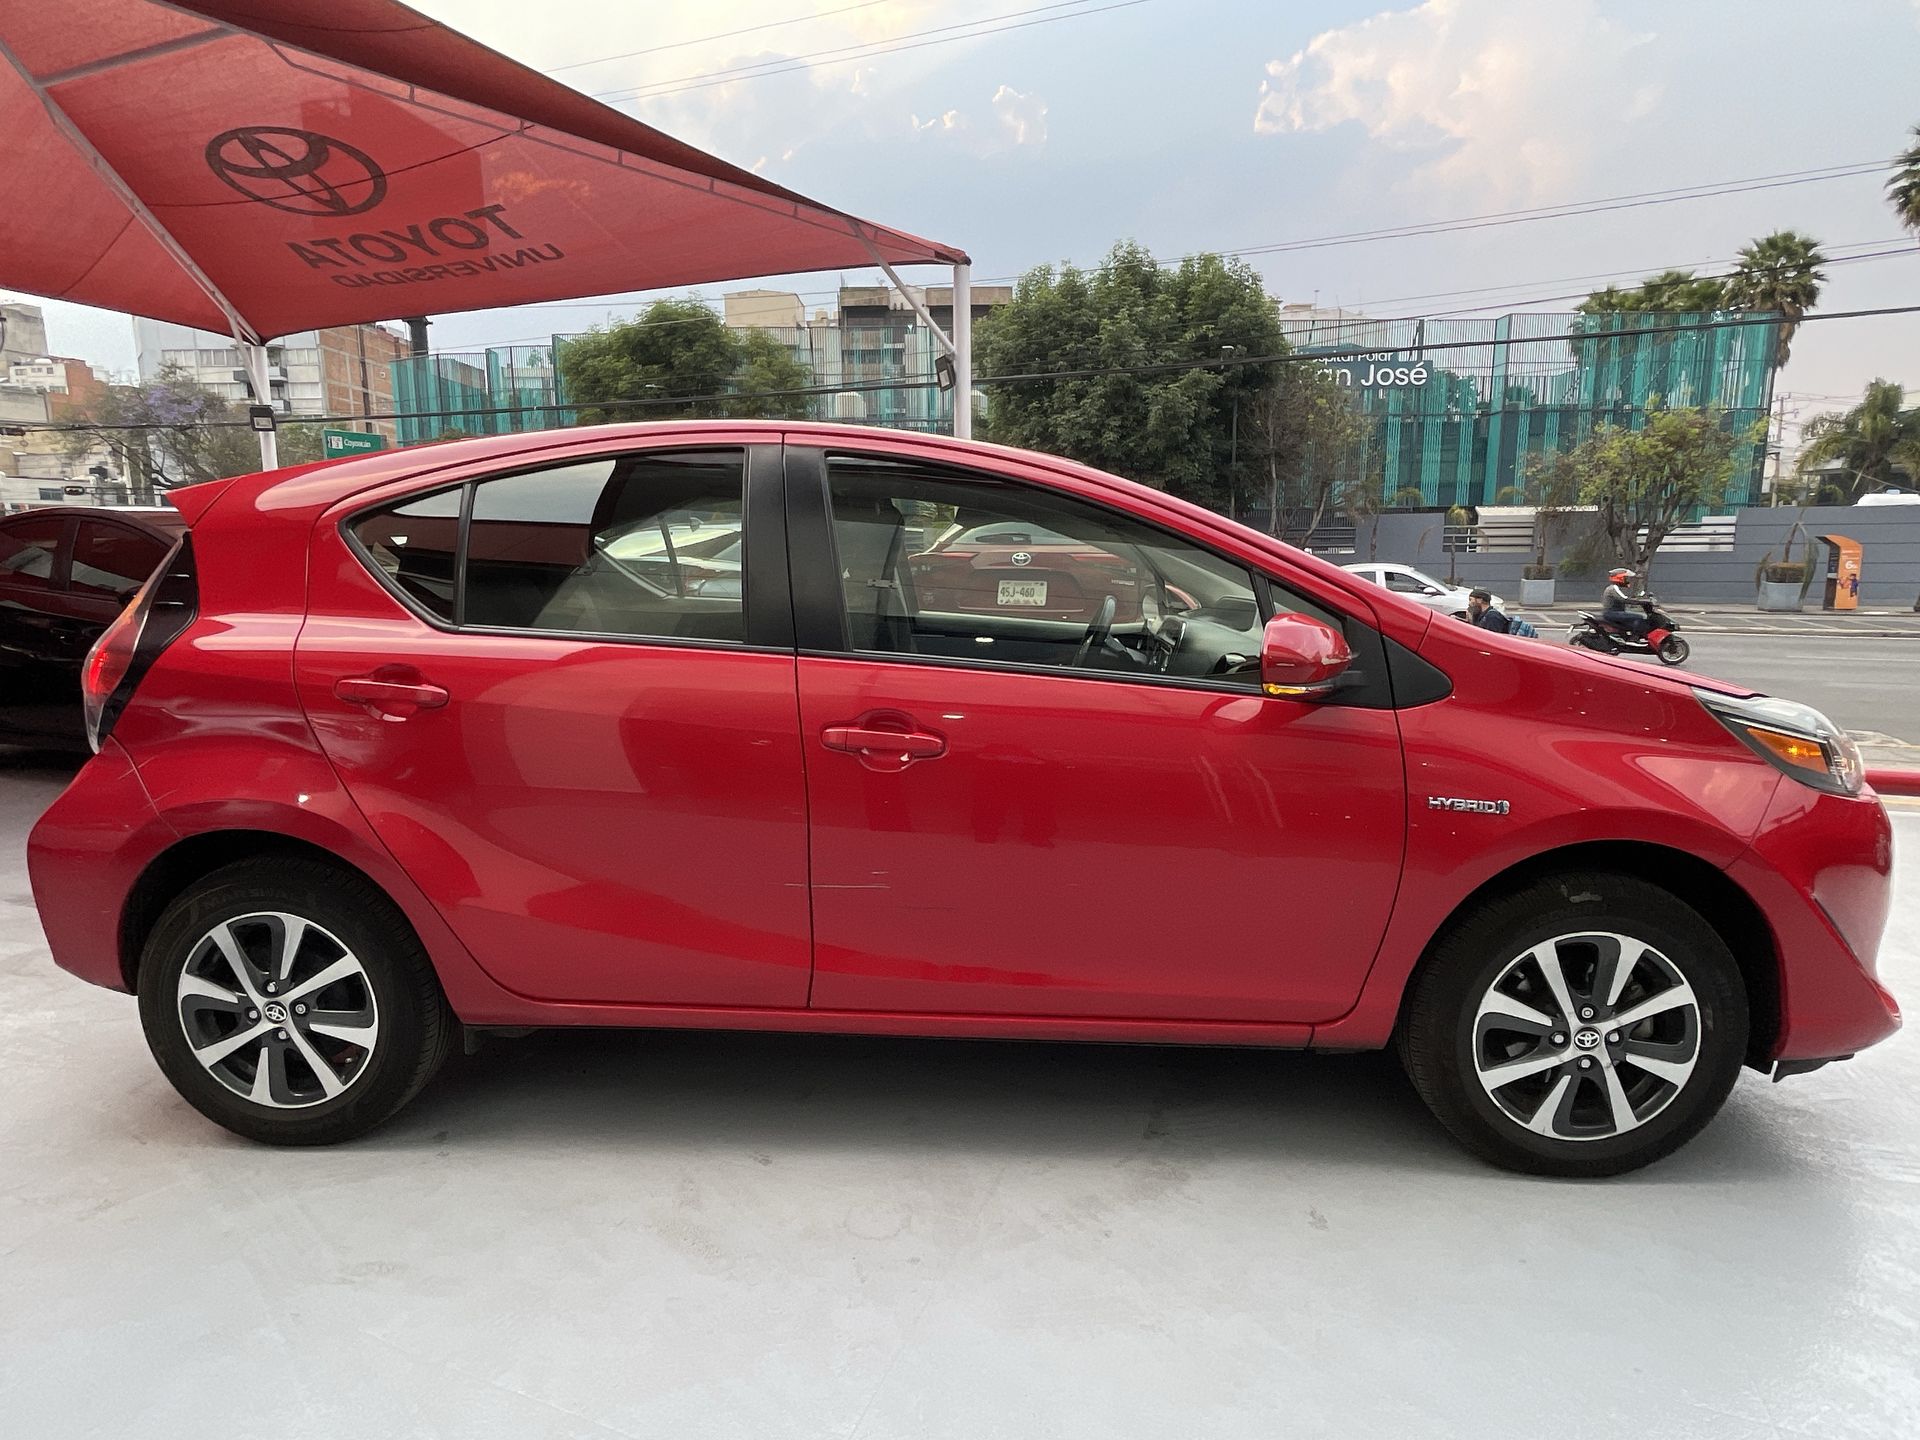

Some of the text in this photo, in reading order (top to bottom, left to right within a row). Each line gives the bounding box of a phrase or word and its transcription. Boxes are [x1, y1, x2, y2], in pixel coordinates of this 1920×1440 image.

[1357, 352, 1394, 363] Polar
[1302, 361, 1428, 387] an José
[1427, 796, 1499, 814] HYBRID
